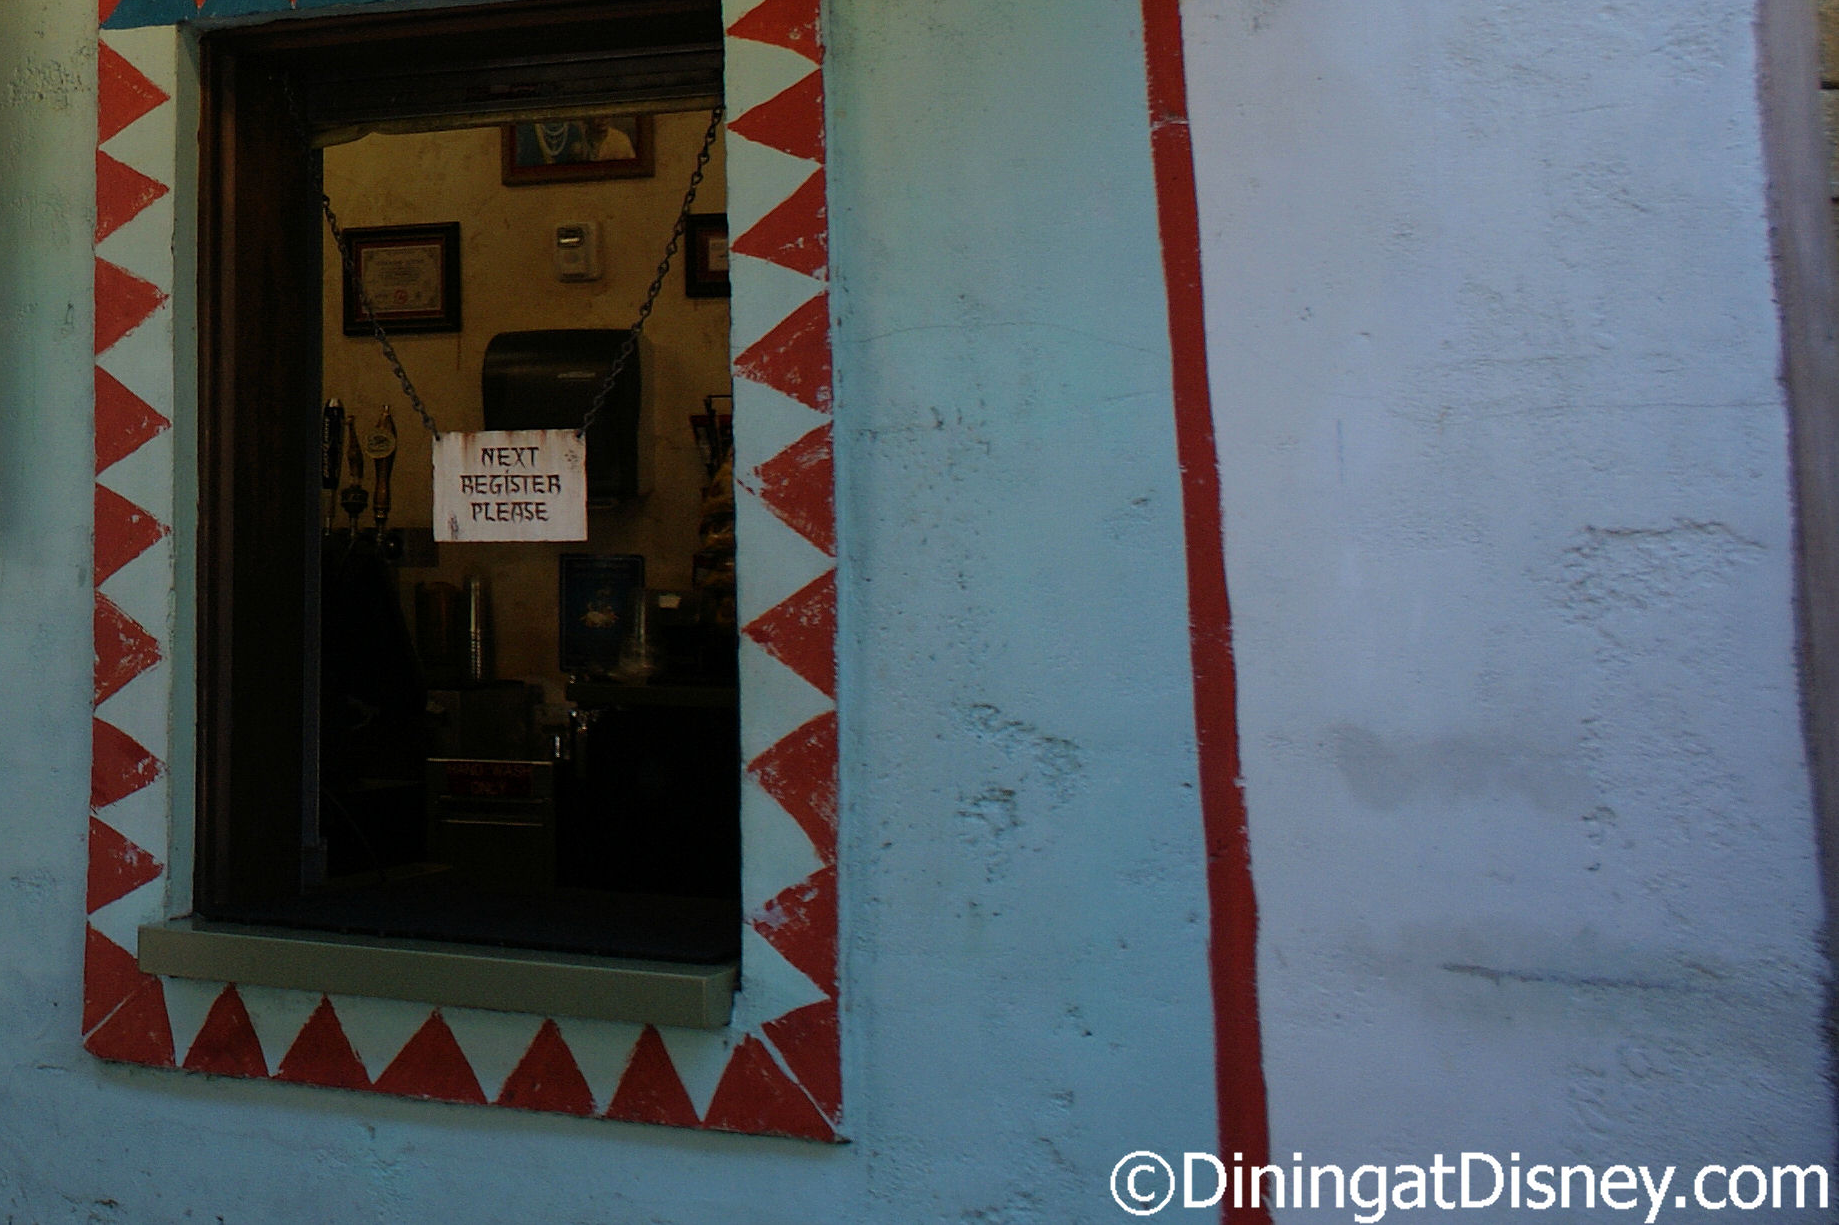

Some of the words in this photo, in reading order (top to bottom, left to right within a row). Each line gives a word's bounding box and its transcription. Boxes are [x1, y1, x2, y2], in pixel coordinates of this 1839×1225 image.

[481, 446, 539, 469] NEXT
[460, 471, 561, 496] REGISTER
[470, 501, 549, 523] PLEASE
